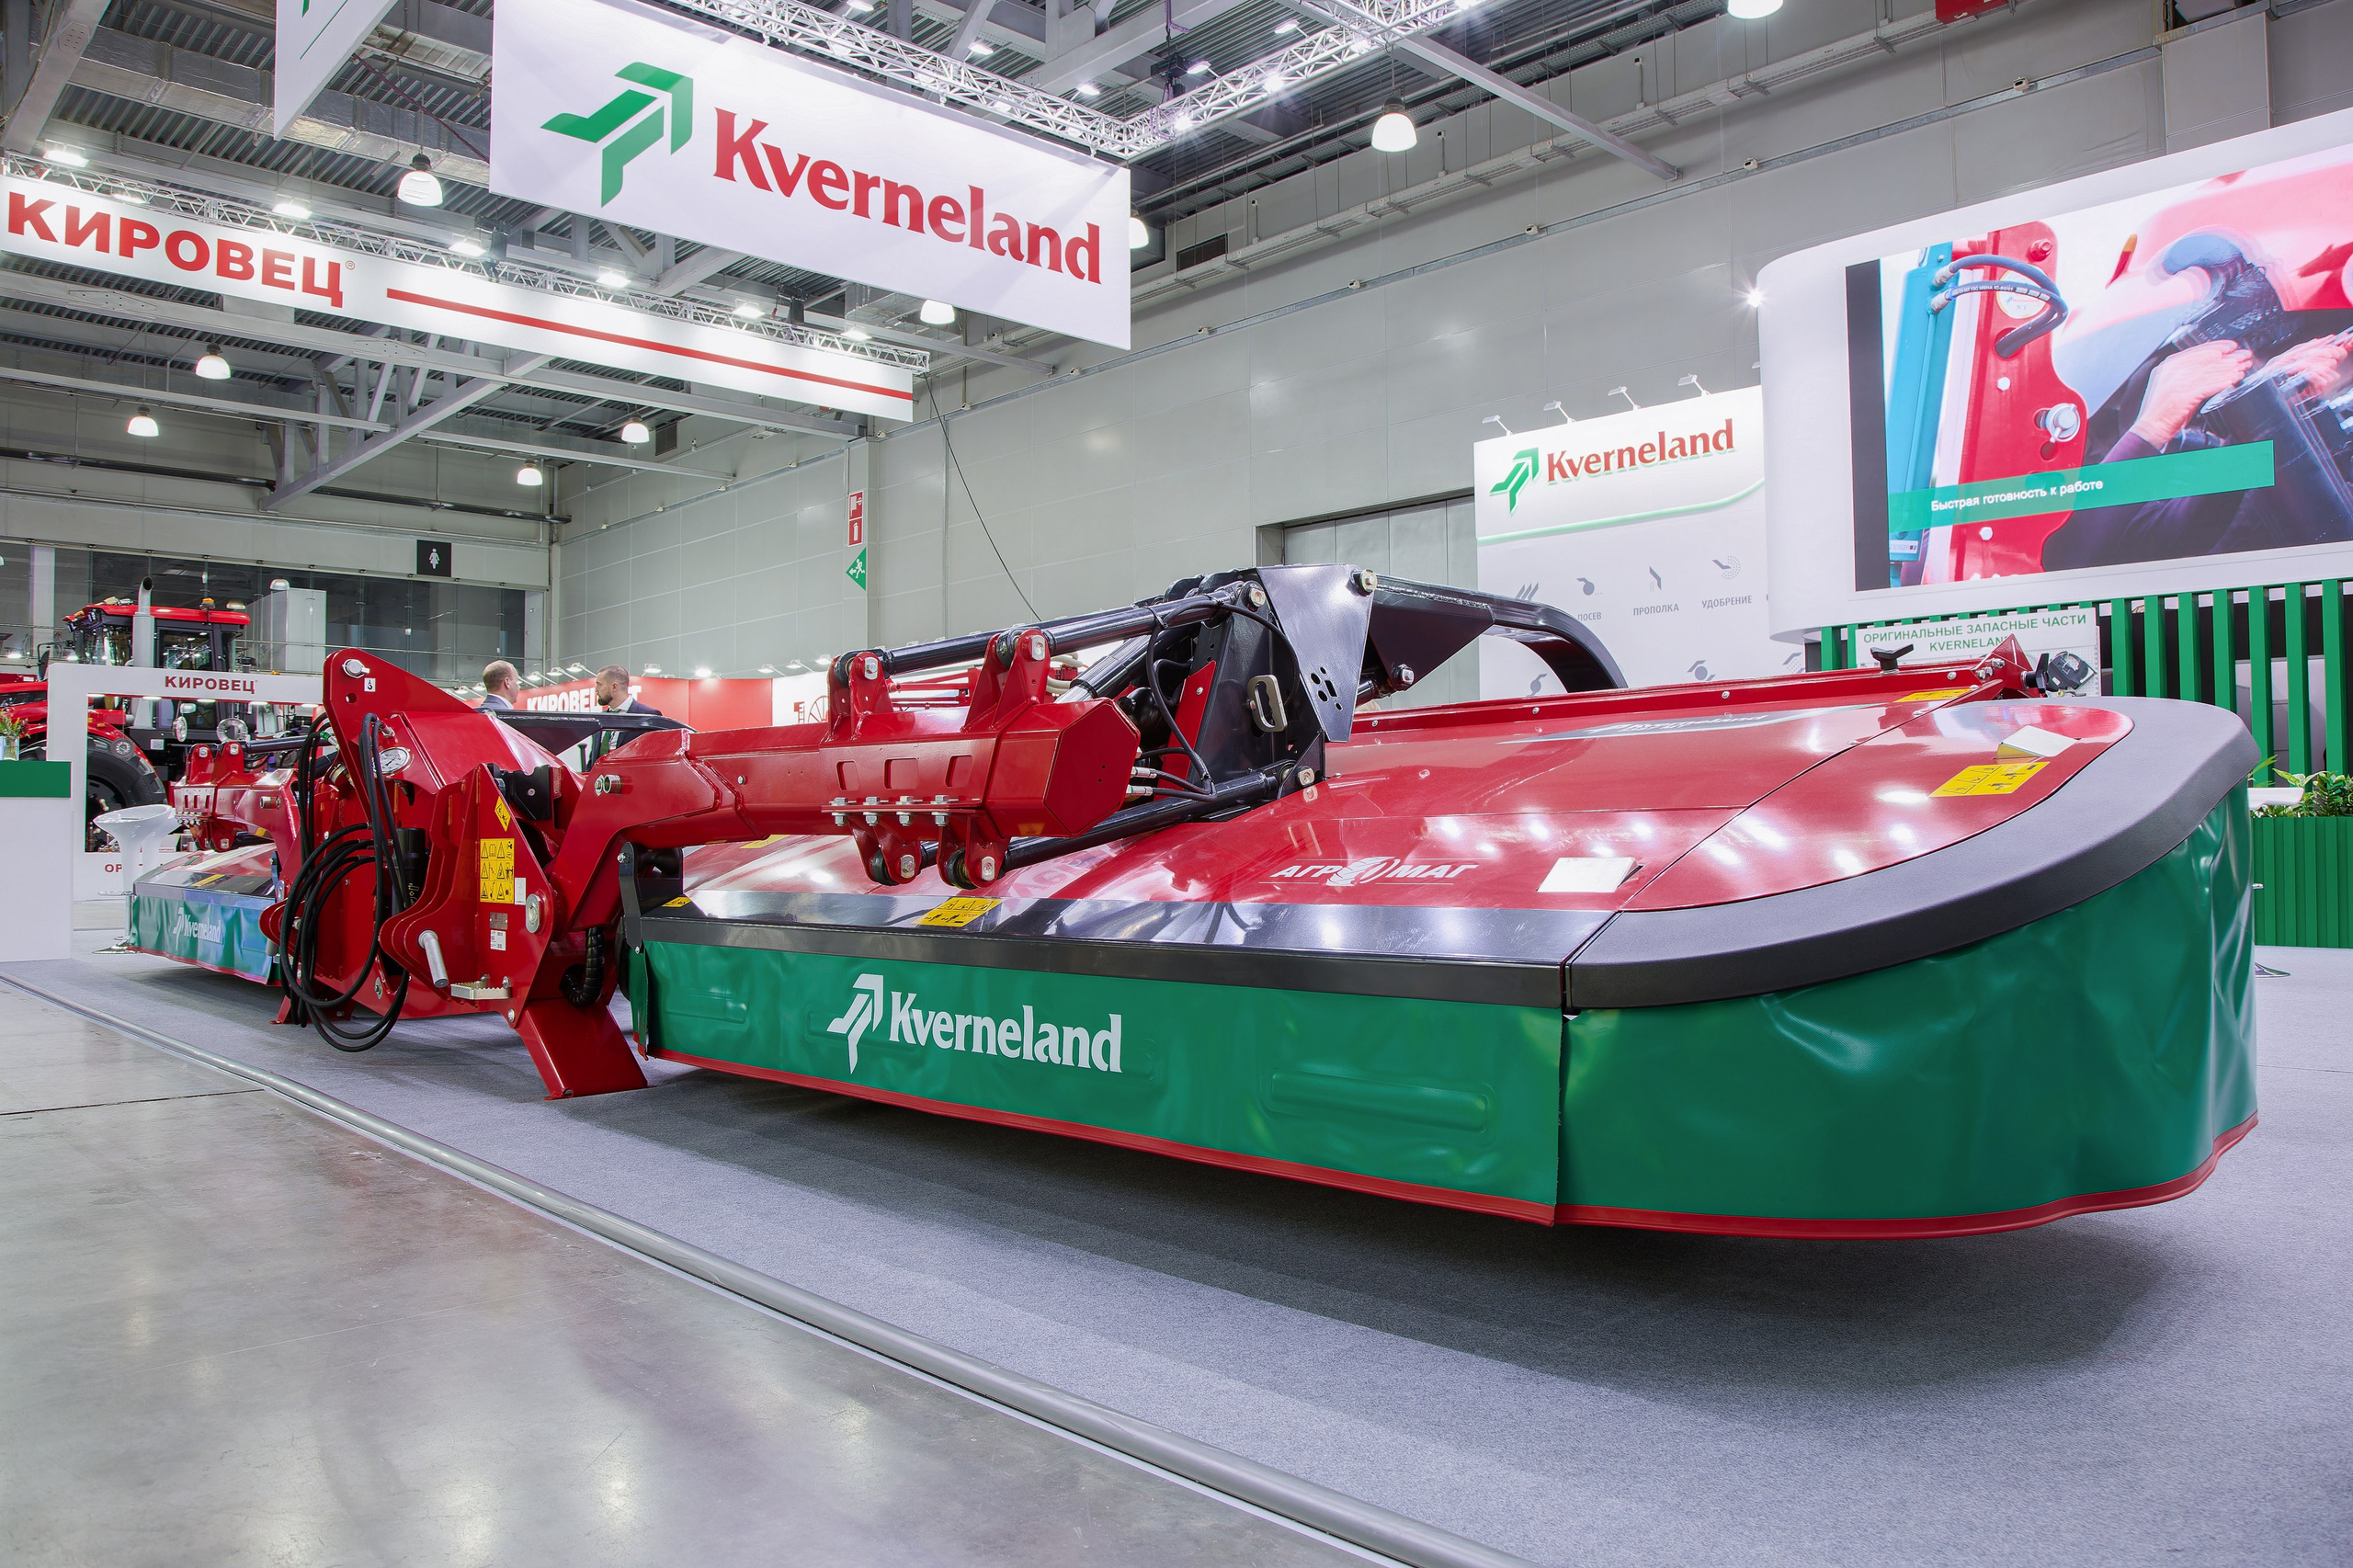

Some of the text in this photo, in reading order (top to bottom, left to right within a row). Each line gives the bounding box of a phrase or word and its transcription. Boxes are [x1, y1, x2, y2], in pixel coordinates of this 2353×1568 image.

[713, 107, 1102, 284] Kverneland
[1547, 417, 1735, 483] Kverneland
[1931, 481, 2104, 511] Быстрая готовность к работе
[1577, 611, 1602, 621] ПОСЕВ
[1633, 603, 1679, 616] ПРОПОЛКА
[1701, 595, 1753, 608] УДОБРЕНИЕ
[1863, 614, 2086, 643] ОРИГИНАЛЬНЫЕ ЗАПАСНЫЕ ЧАСТИ
[1929, 635, 2007, 652] KVERNELAN
[165, 676, 256, 694] КИРОВЕЦ
[184, 914, 222, 944] Kverneland
[889, 991, 1122, 1074] Kverneland
